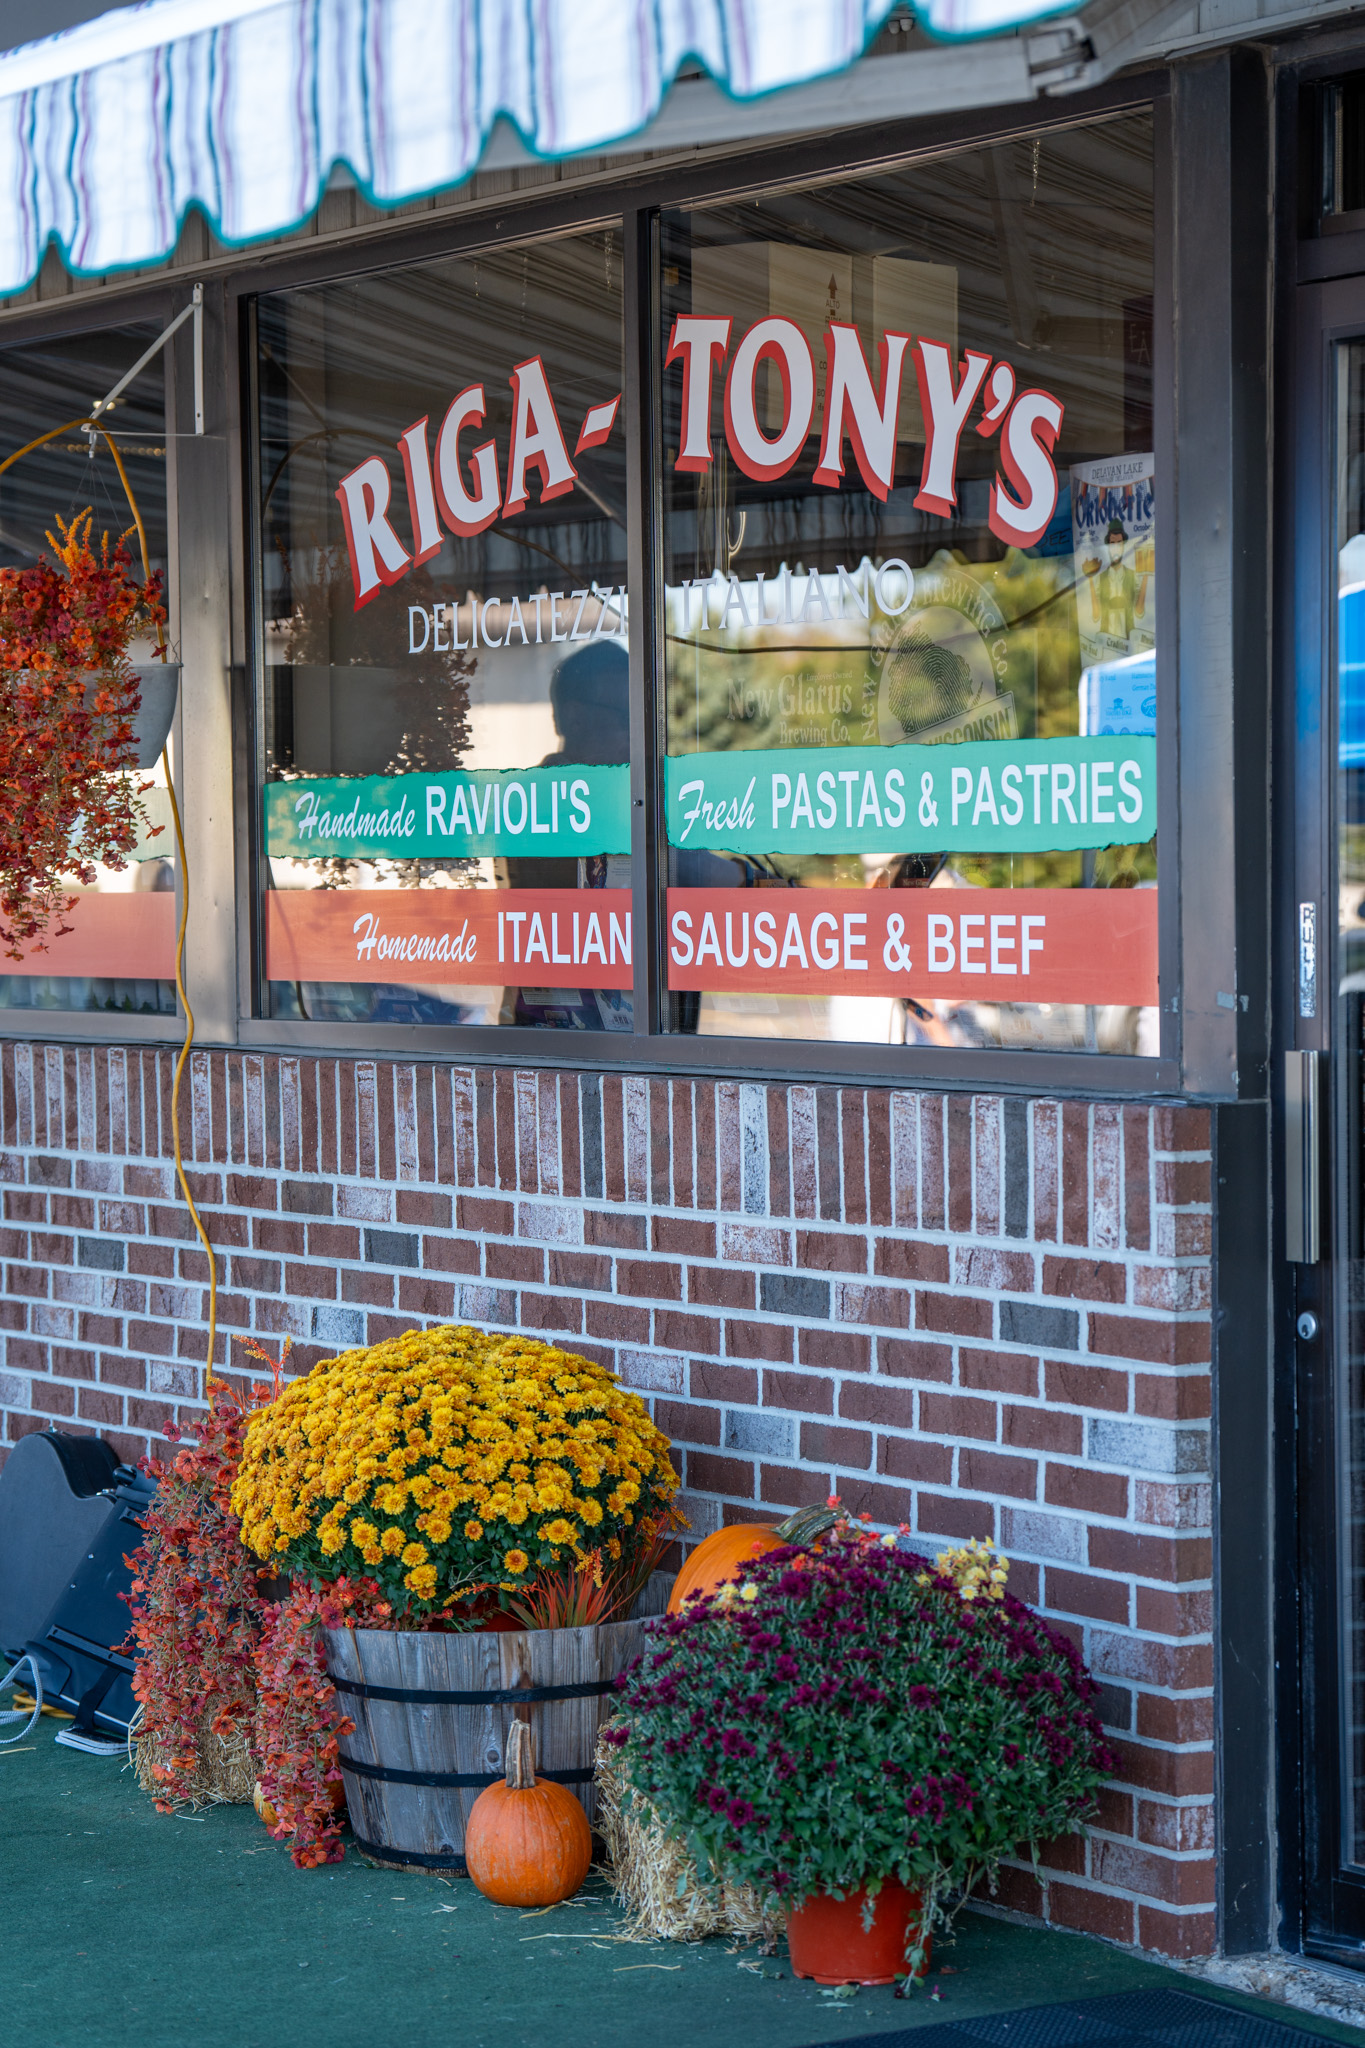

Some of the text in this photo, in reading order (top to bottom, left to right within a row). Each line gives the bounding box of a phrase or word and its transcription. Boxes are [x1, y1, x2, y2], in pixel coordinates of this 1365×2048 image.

[335, 313, 1065, 613] RIGA- TONY'S
[1075, 484, 1155, 529] Oktoberfe
[407, 557, 915, 655] DELICATEZZI ITALIANO
[726, 671, 853, 721] New Glarus
[924, 707, 1012, 746] CONSIN
[779, 719, 829, 748] Brewing
[294, 779, 591, 840] Handmade RAVIOLI'S
[677, 759, 1144, 843] Fresh PASTAS & PASTRIES
[352, 910, 1047, 976] Homemade ITALIAN SAUSAGE & BEEF
